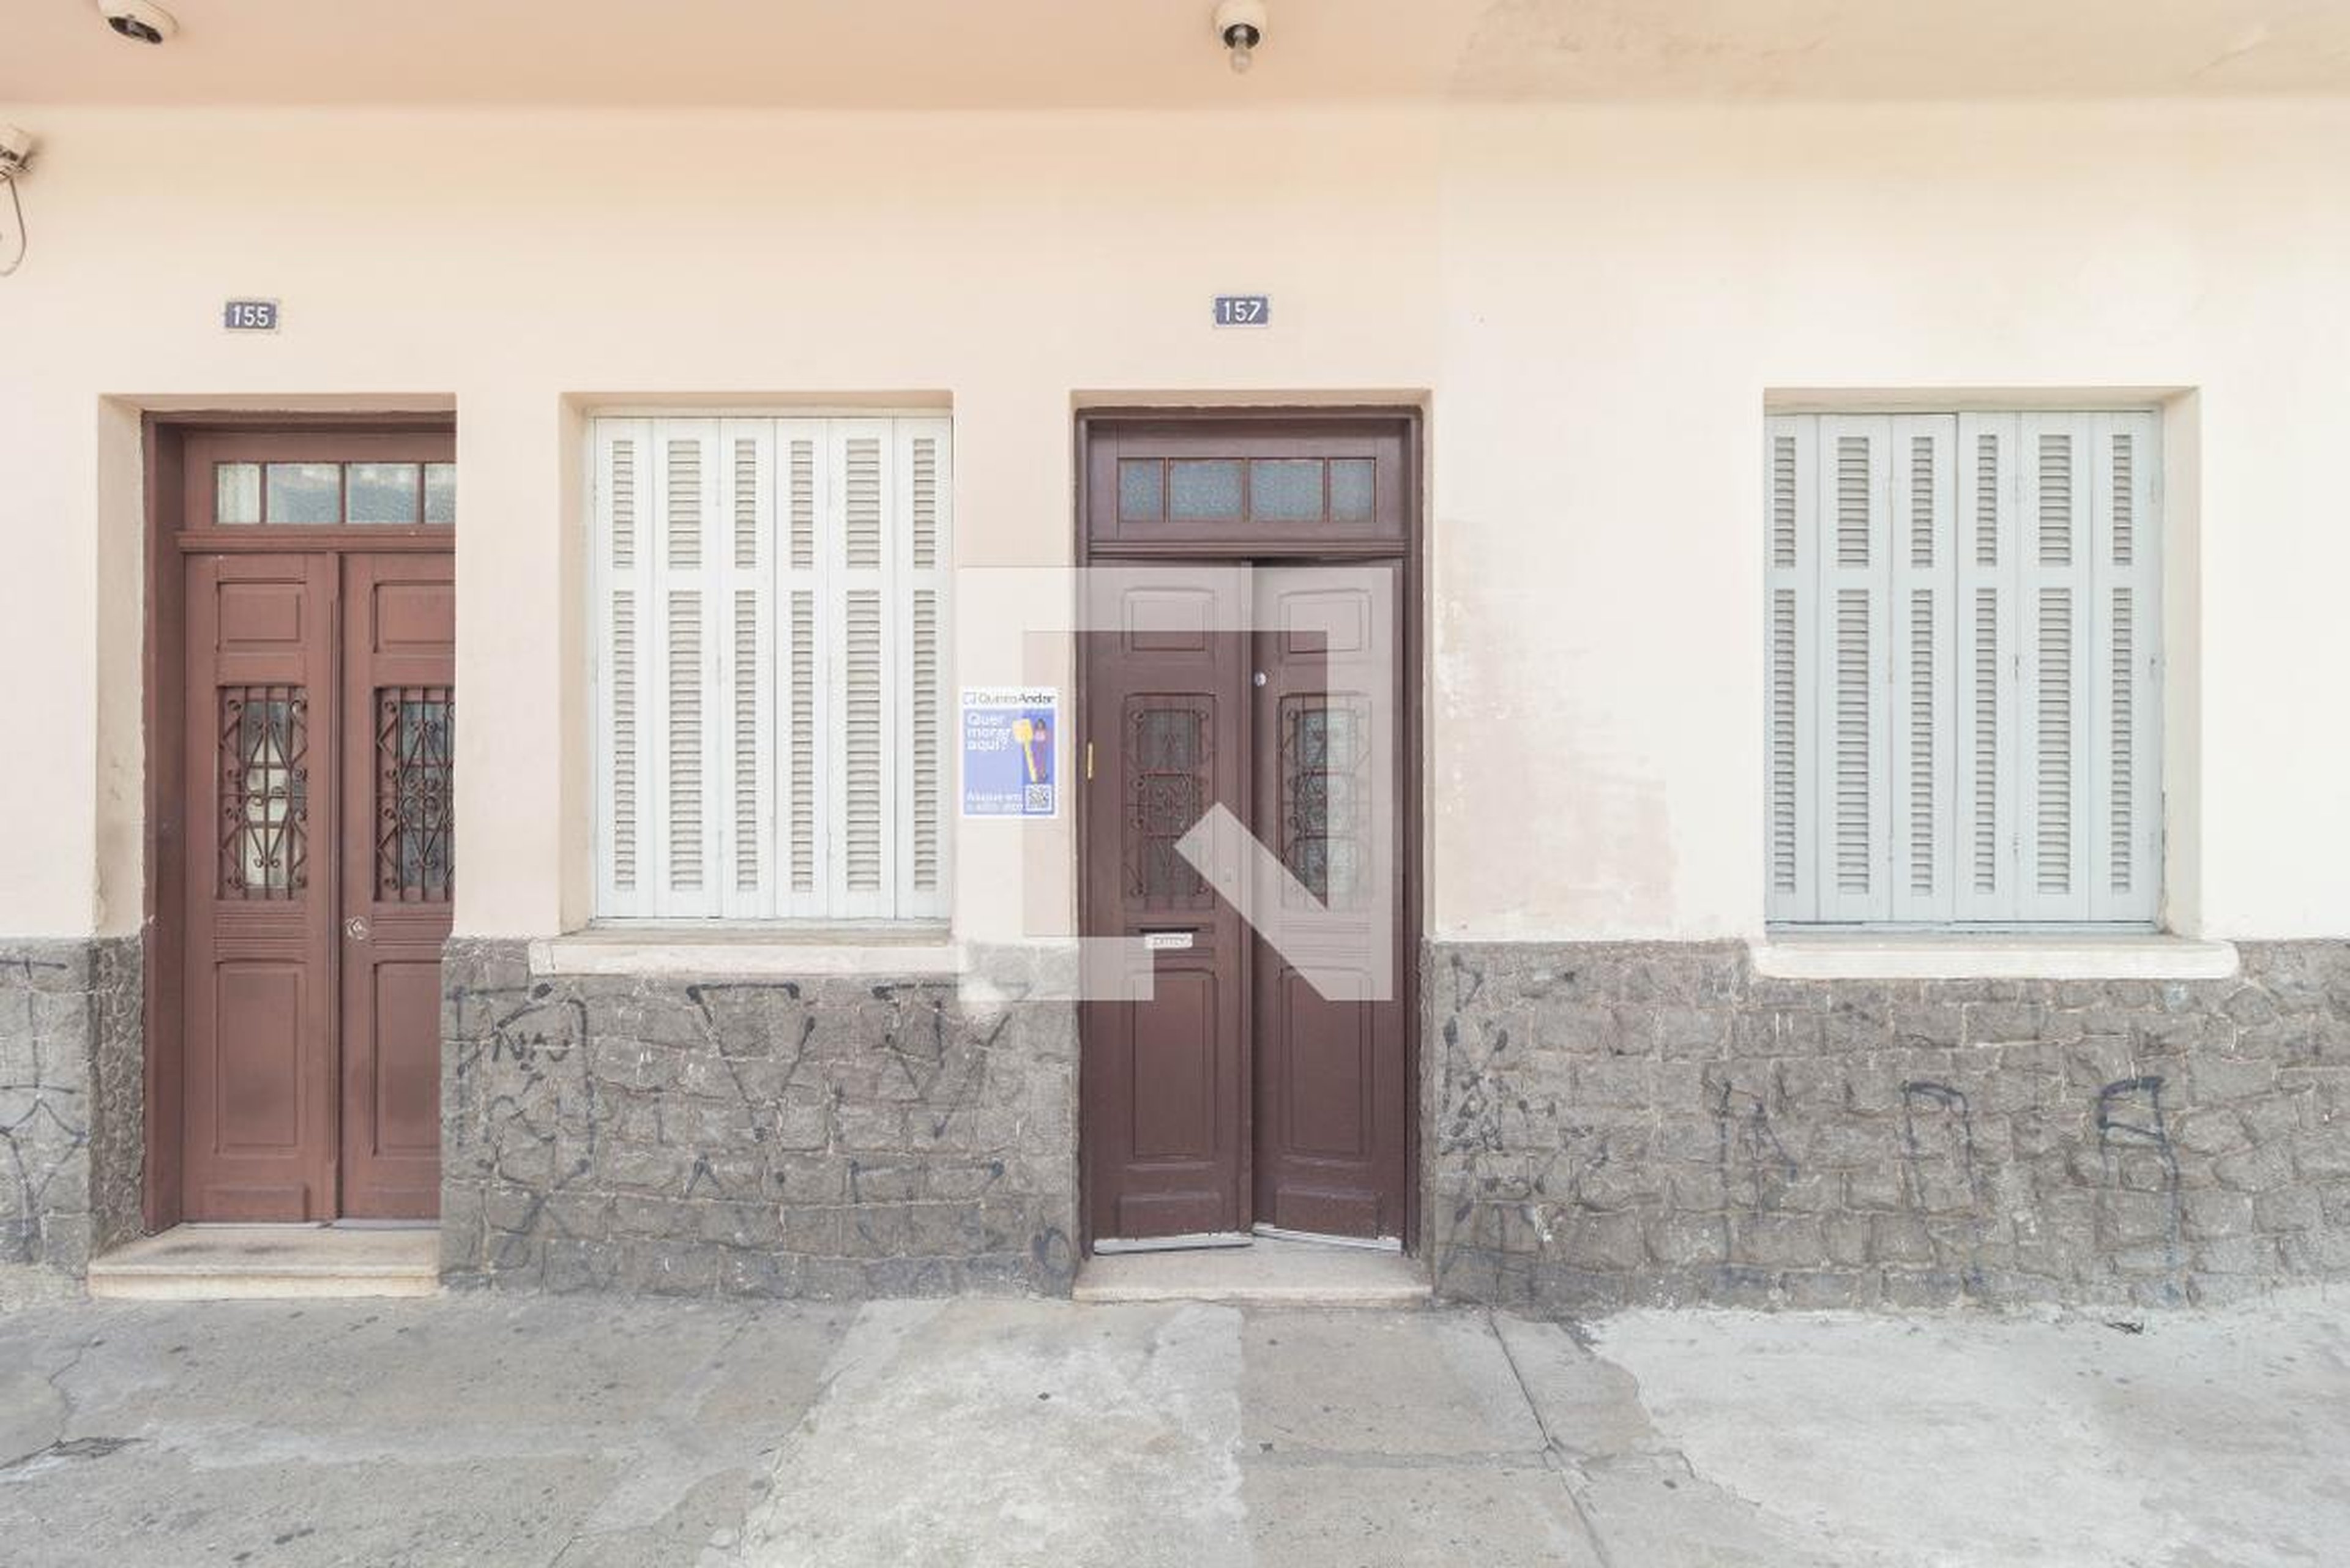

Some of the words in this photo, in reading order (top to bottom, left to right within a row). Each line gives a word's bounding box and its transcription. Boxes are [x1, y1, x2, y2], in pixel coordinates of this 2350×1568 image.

[233, 305, 269, 326] 155
[1225, 301, 1261, 321] 157
[967, 712, 1005, 726] Quer
